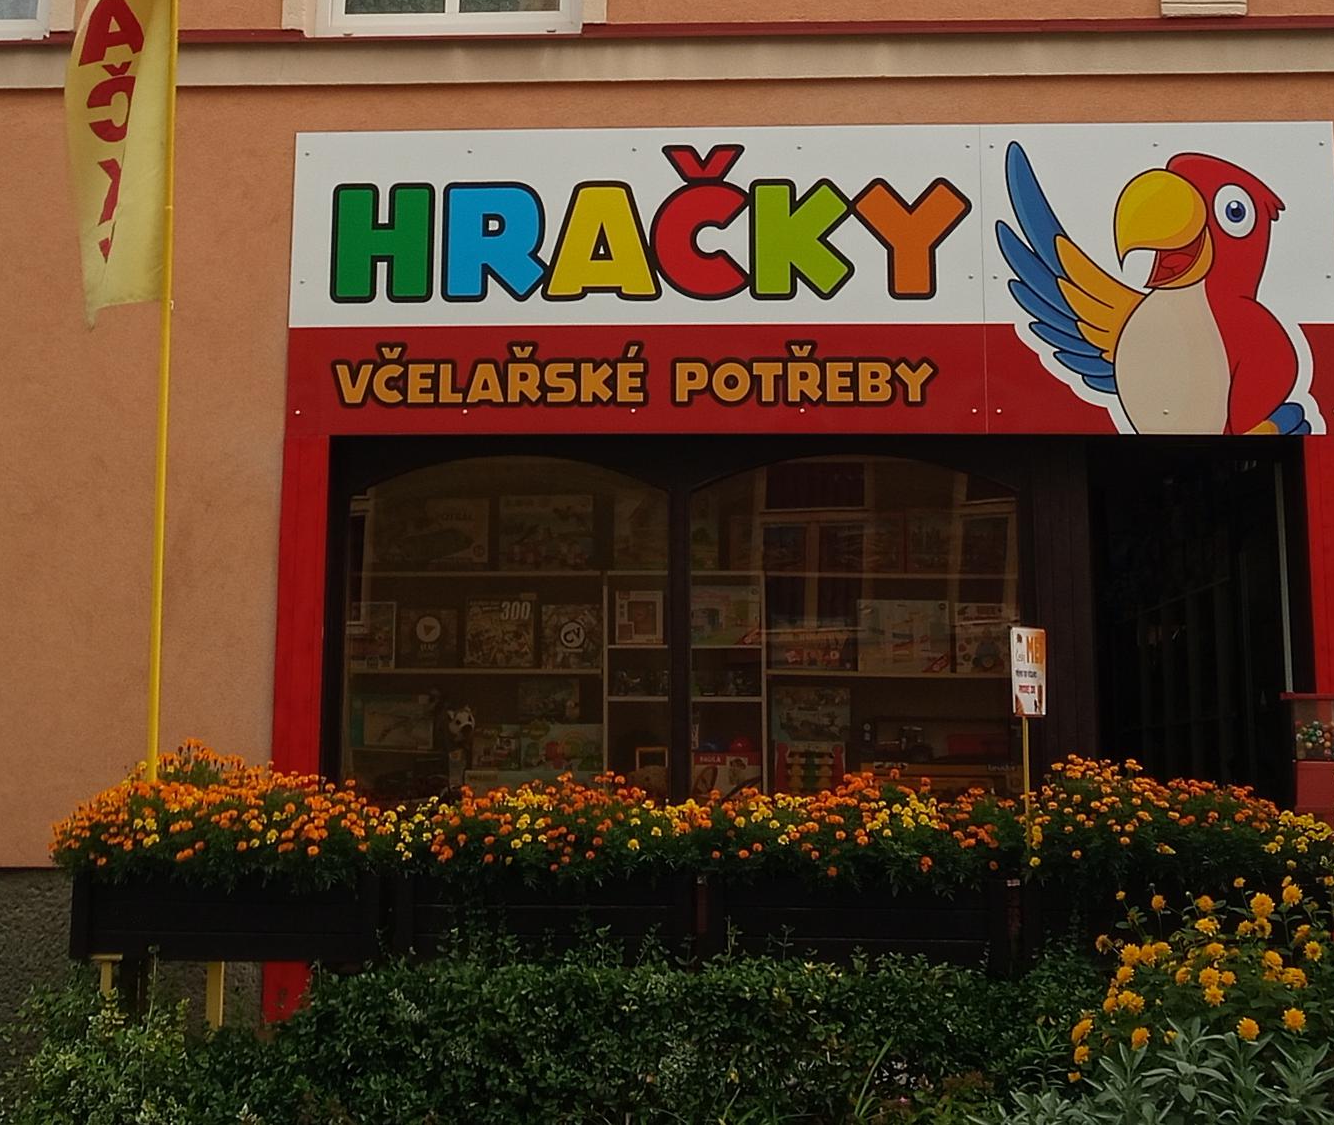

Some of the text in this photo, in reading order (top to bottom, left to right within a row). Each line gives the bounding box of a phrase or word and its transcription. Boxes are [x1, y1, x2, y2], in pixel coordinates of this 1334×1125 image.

[330, 144, 972, 303] HRAČKY
[332, 339, 939, 409] VČELAŘSKÉ POTŘEBY
[500, 601, 532, 621] 300
